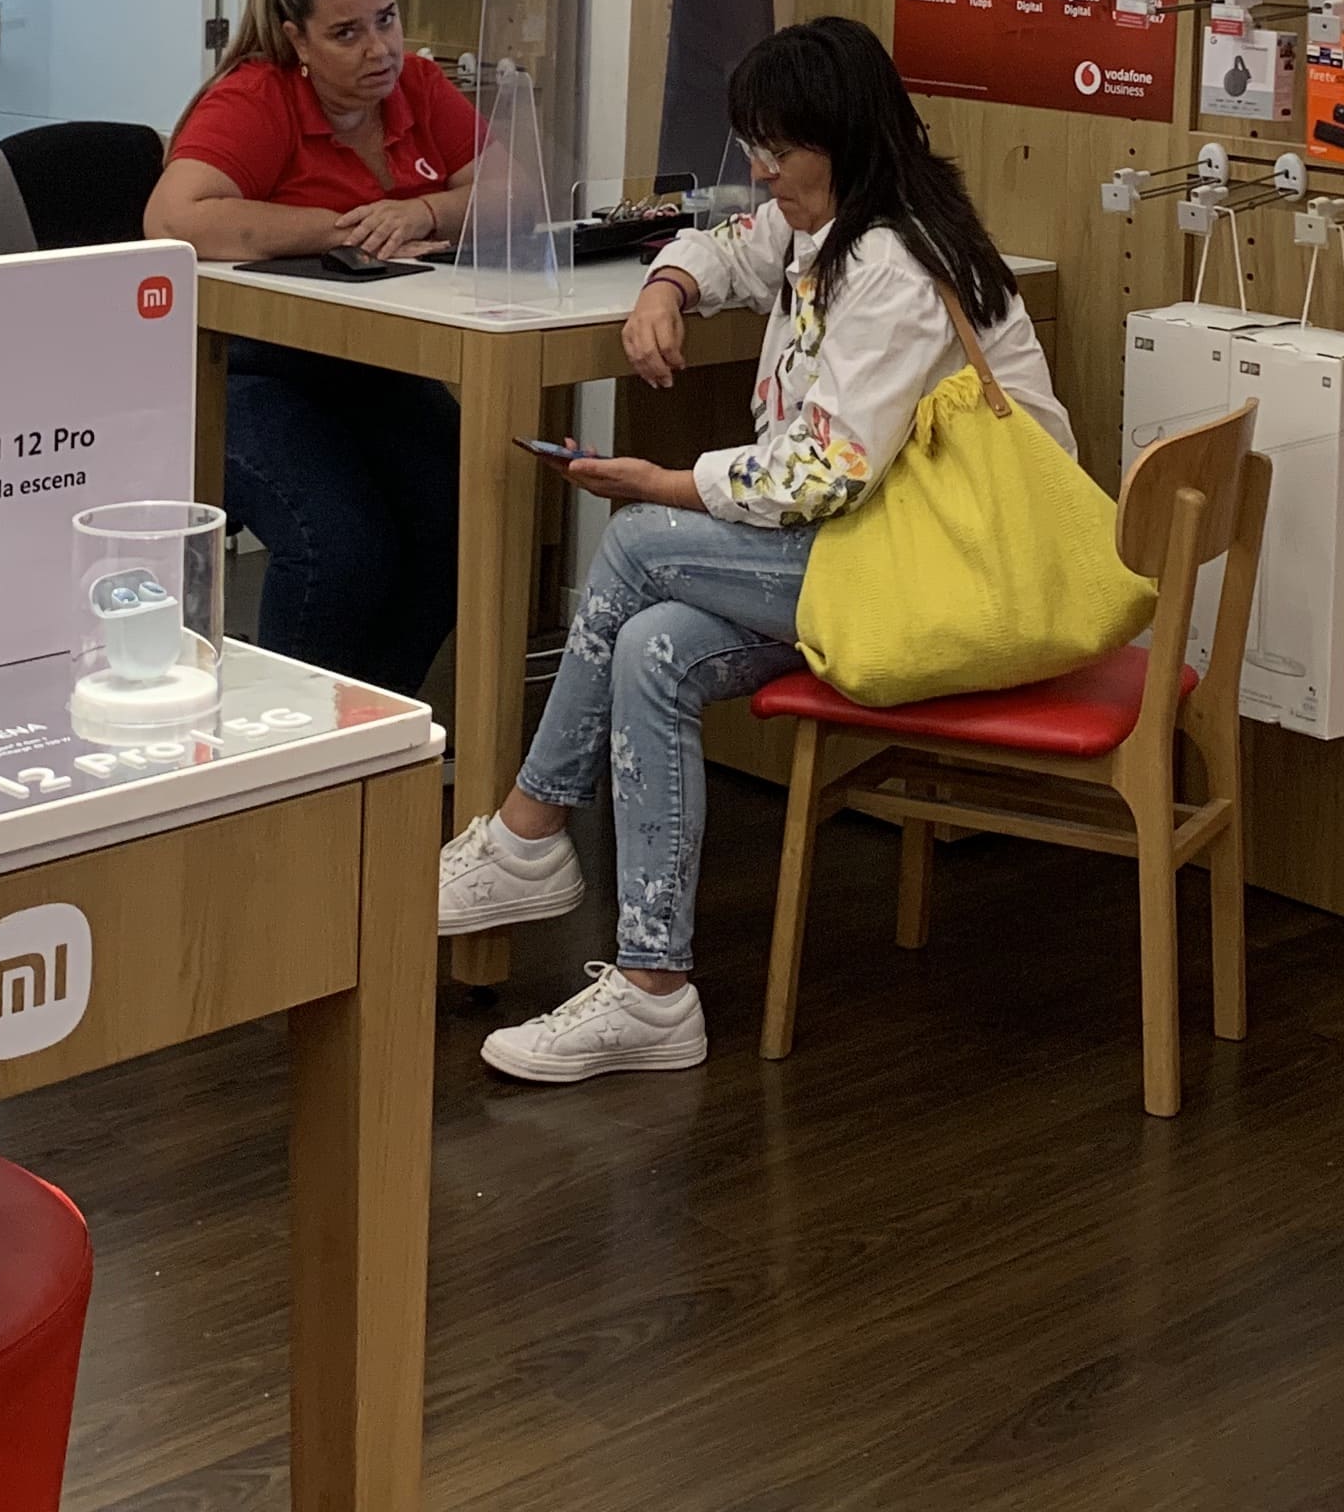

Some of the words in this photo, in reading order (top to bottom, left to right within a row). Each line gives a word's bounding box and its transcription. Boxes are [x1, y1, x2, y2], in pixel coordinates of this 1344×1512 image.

[1016, 0, 1043, 13] Digital
[1064, 4, 1091, 17] Digital
[1105, 69, 1152, 84] vodafone
[1104, 82, 1144, 97] business
[14, 432, 42, 457] 12
[54, 426, 96, 453] Pro
[20, 469, 87, 496] escena
[74, 738, 185, 778] Pro
[224, 706, 313, 744] 5G
